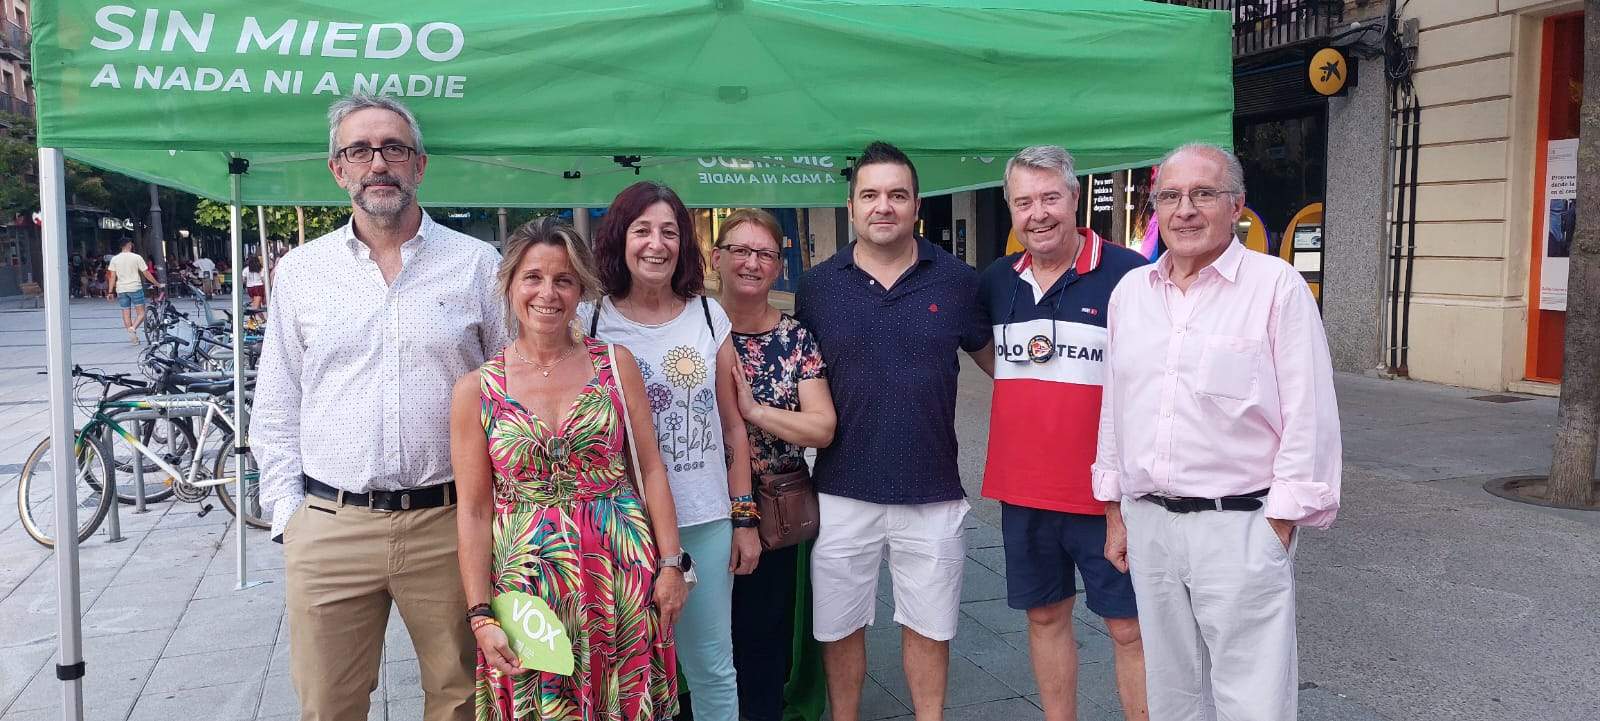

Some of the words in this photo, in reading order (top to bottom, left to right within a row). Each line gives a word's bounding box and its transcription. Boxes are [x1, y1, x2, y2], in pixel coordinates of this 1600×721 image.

[90, 5, 216, 53] SIN
[235, 16, 465, 62] MIEDO
[90, 63, 121, 89] A
[133, 65, 252, 93] NADA
[263, 69, 304, 95] NI
[312, 71, 341, 96] A
[352, 72, 467, 99] NADIE
[1057, 344, 1103, 363] TEAM
[512, 598, 562, 651] VOX
